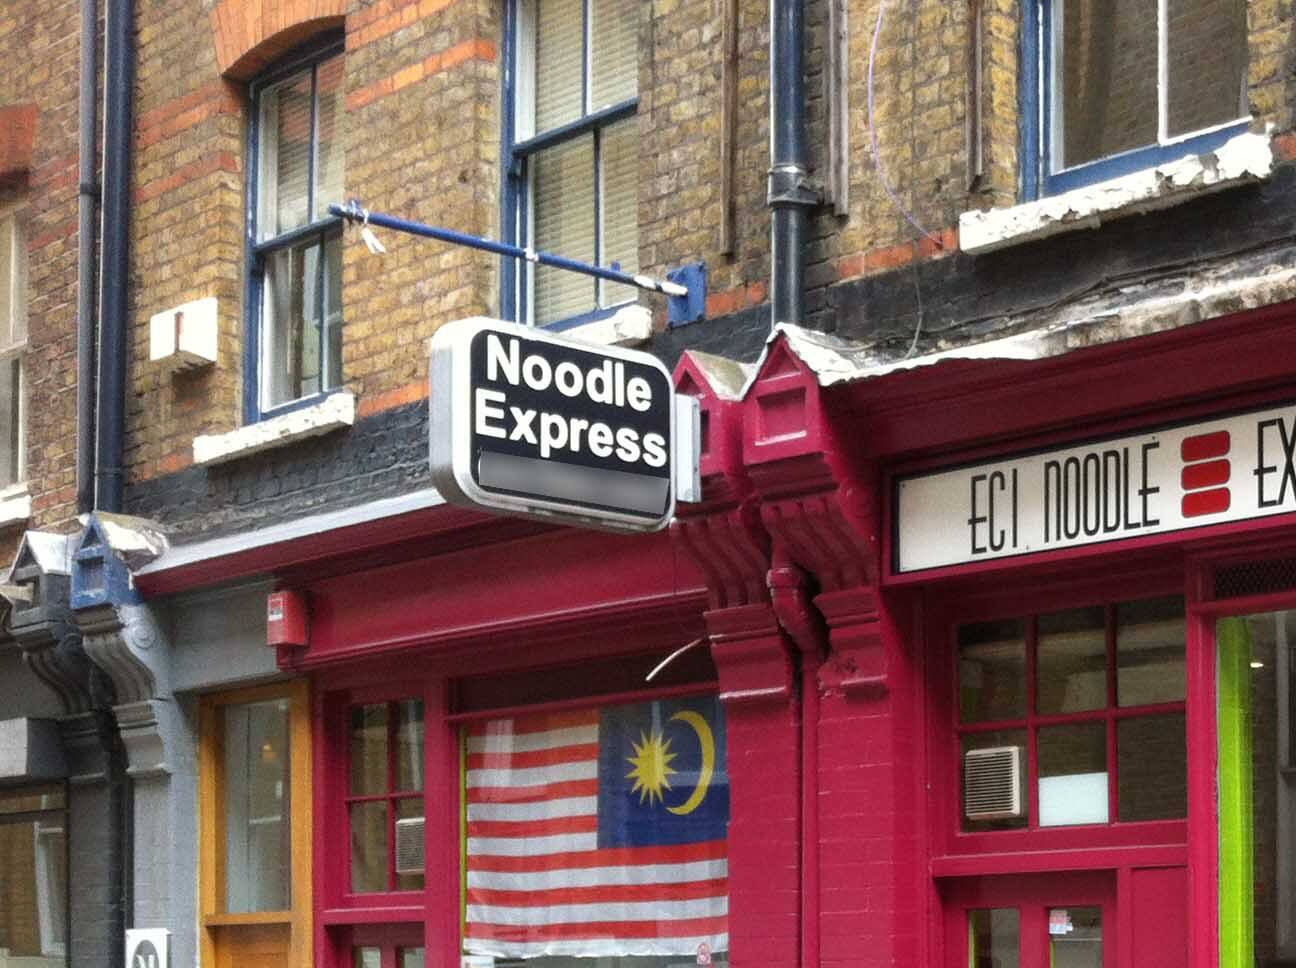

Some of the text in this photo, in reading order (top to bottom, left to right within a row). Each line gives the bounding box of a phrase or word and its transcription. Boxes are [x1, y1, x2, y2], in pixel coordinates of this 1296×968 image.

[487, 334, 652, 411] Noodle
[475, 389, 667, 467] Express
[1044, 442, 1160, 543] NOODLE
